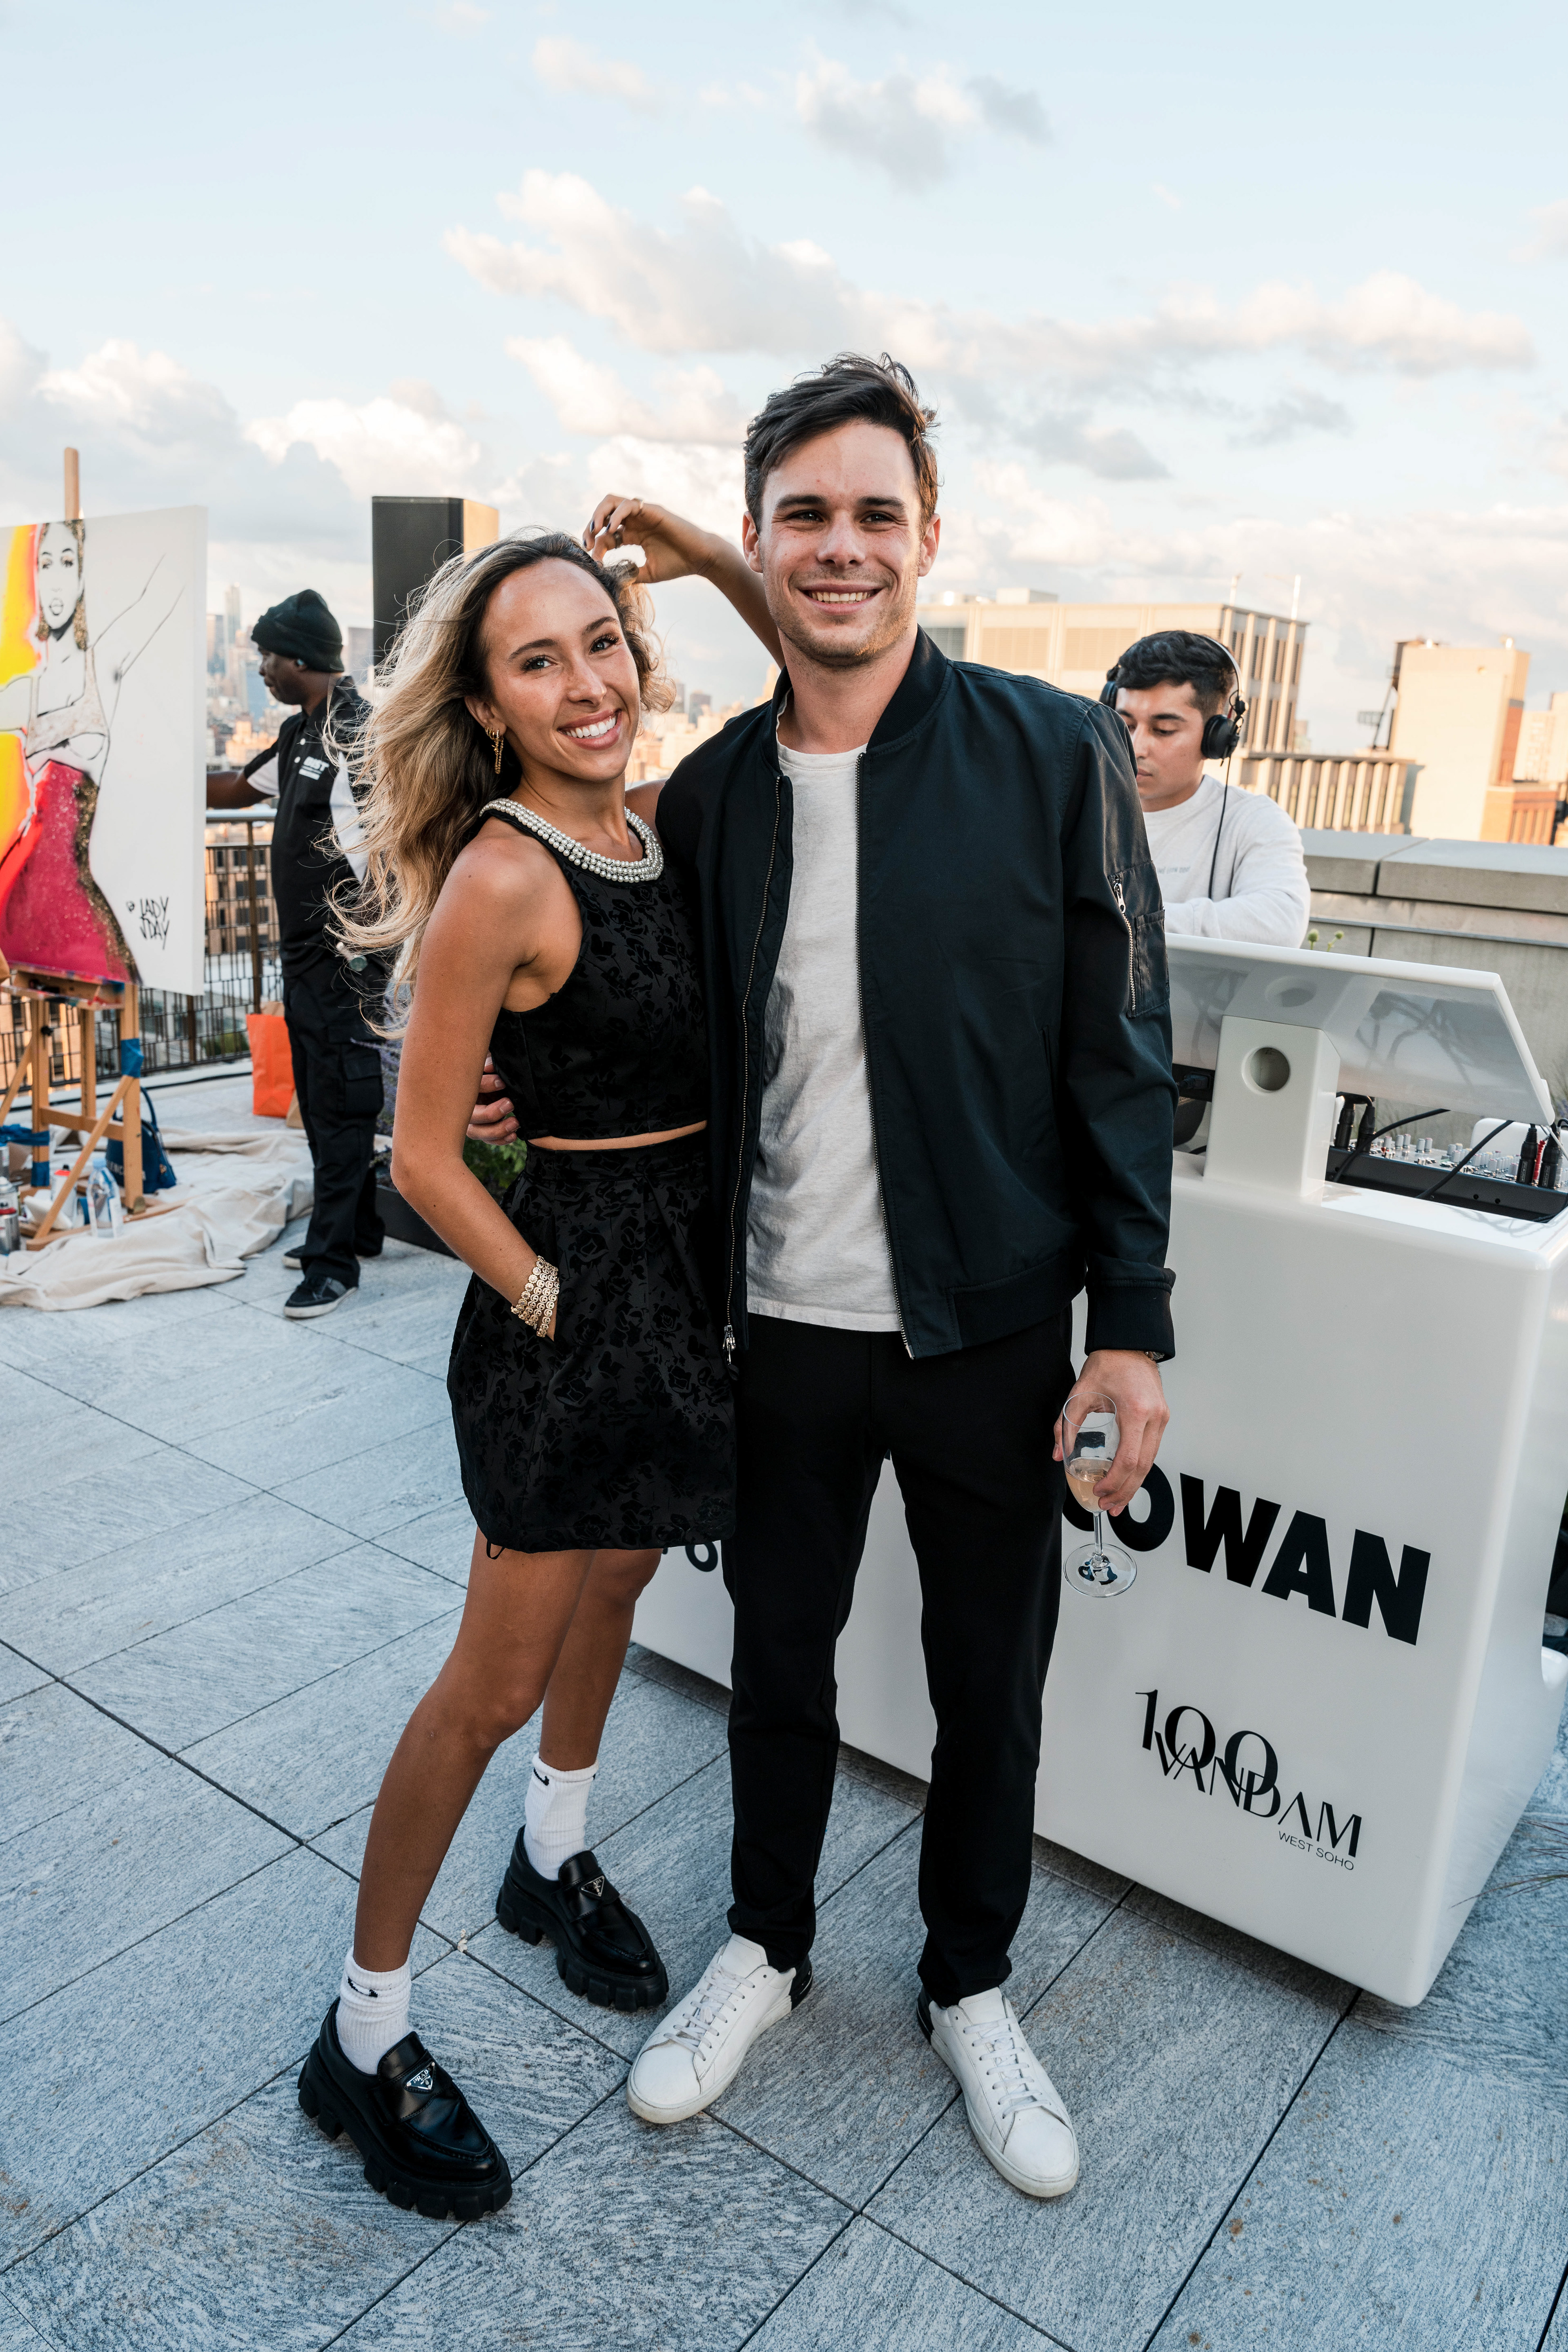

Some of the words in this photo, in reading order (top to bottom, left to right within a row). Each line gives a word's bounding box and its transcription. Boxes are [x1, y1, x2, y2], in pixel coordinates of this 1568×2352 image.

[140, 896, 169, 922] LADY
[1062, 1463, 1431, 1646] OWAN
[1135, 1689, 1278, 1796] 100
[1154, 1731, 1362, 1858] VANDAM
[1279, 1831, 1313, 1852] WEST
[1316, 1848, 1354, 1870] SOHO
